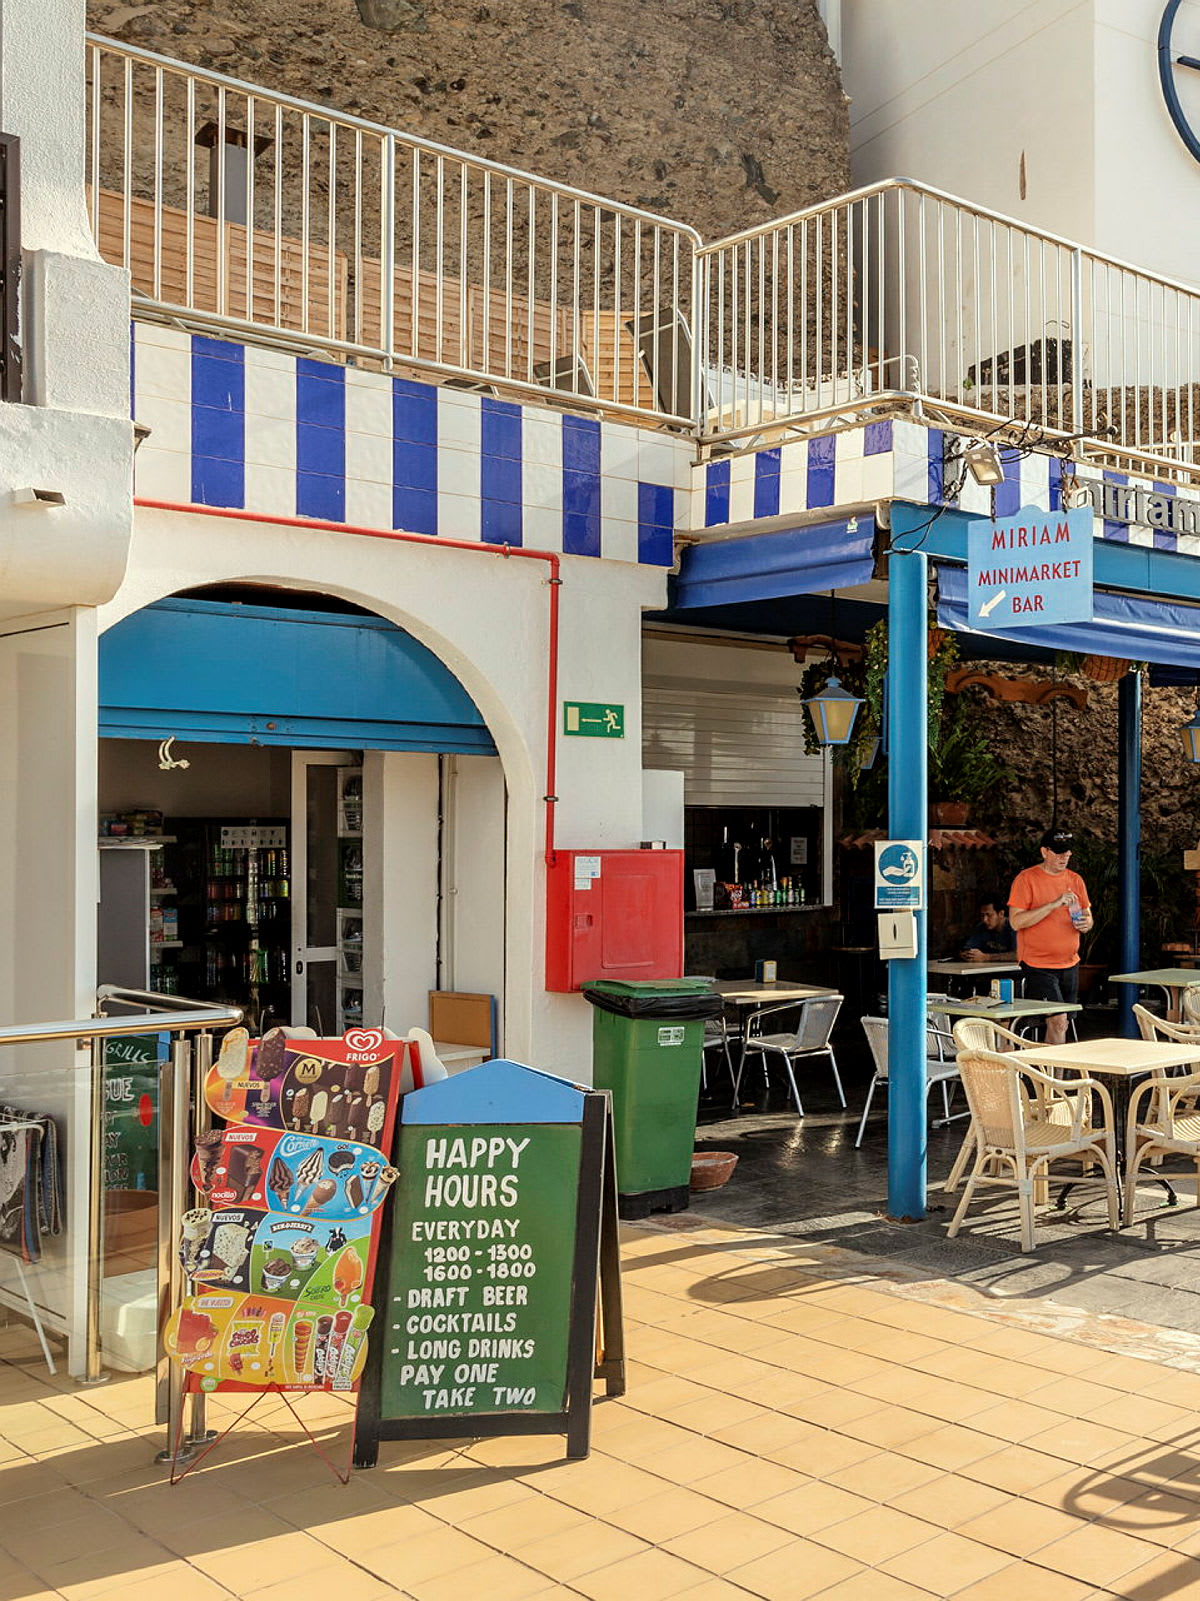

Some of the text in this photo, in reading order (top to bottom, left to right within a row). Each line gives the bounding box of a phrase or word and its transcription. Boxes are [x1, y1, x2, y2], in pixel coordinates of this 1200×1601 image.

[992, 521, 1070, 550] MIRIAM
[978, 560, 1081, 586] MINIMARKET
[1012, 595, 1044, 614] BAR
[346, 1052, 378, 1062] FRIGO
[228, 1133, 255, 1141] NUEVOS
[426, 1137, 531, 1168] HAPPY
[425, 1174, 519, 1208] HOURS
[215, 1213, 242, 1221] NUEVOS
[412, 1219, 520, 1241] EVERYDAY
[408, 1287, 469, 1309] DRAFT
[483, 1285, 528, 1306] BEER
[406, 1312, 517, 1334] COCKTAILS
[407, 1339, 462, 1360] LONG
[468, 1338, 535, 1359] DRINKS
[400, 1363, 499, 1386] PAY ONE
[422, 1387, 536, 1410] TAKE TWO
